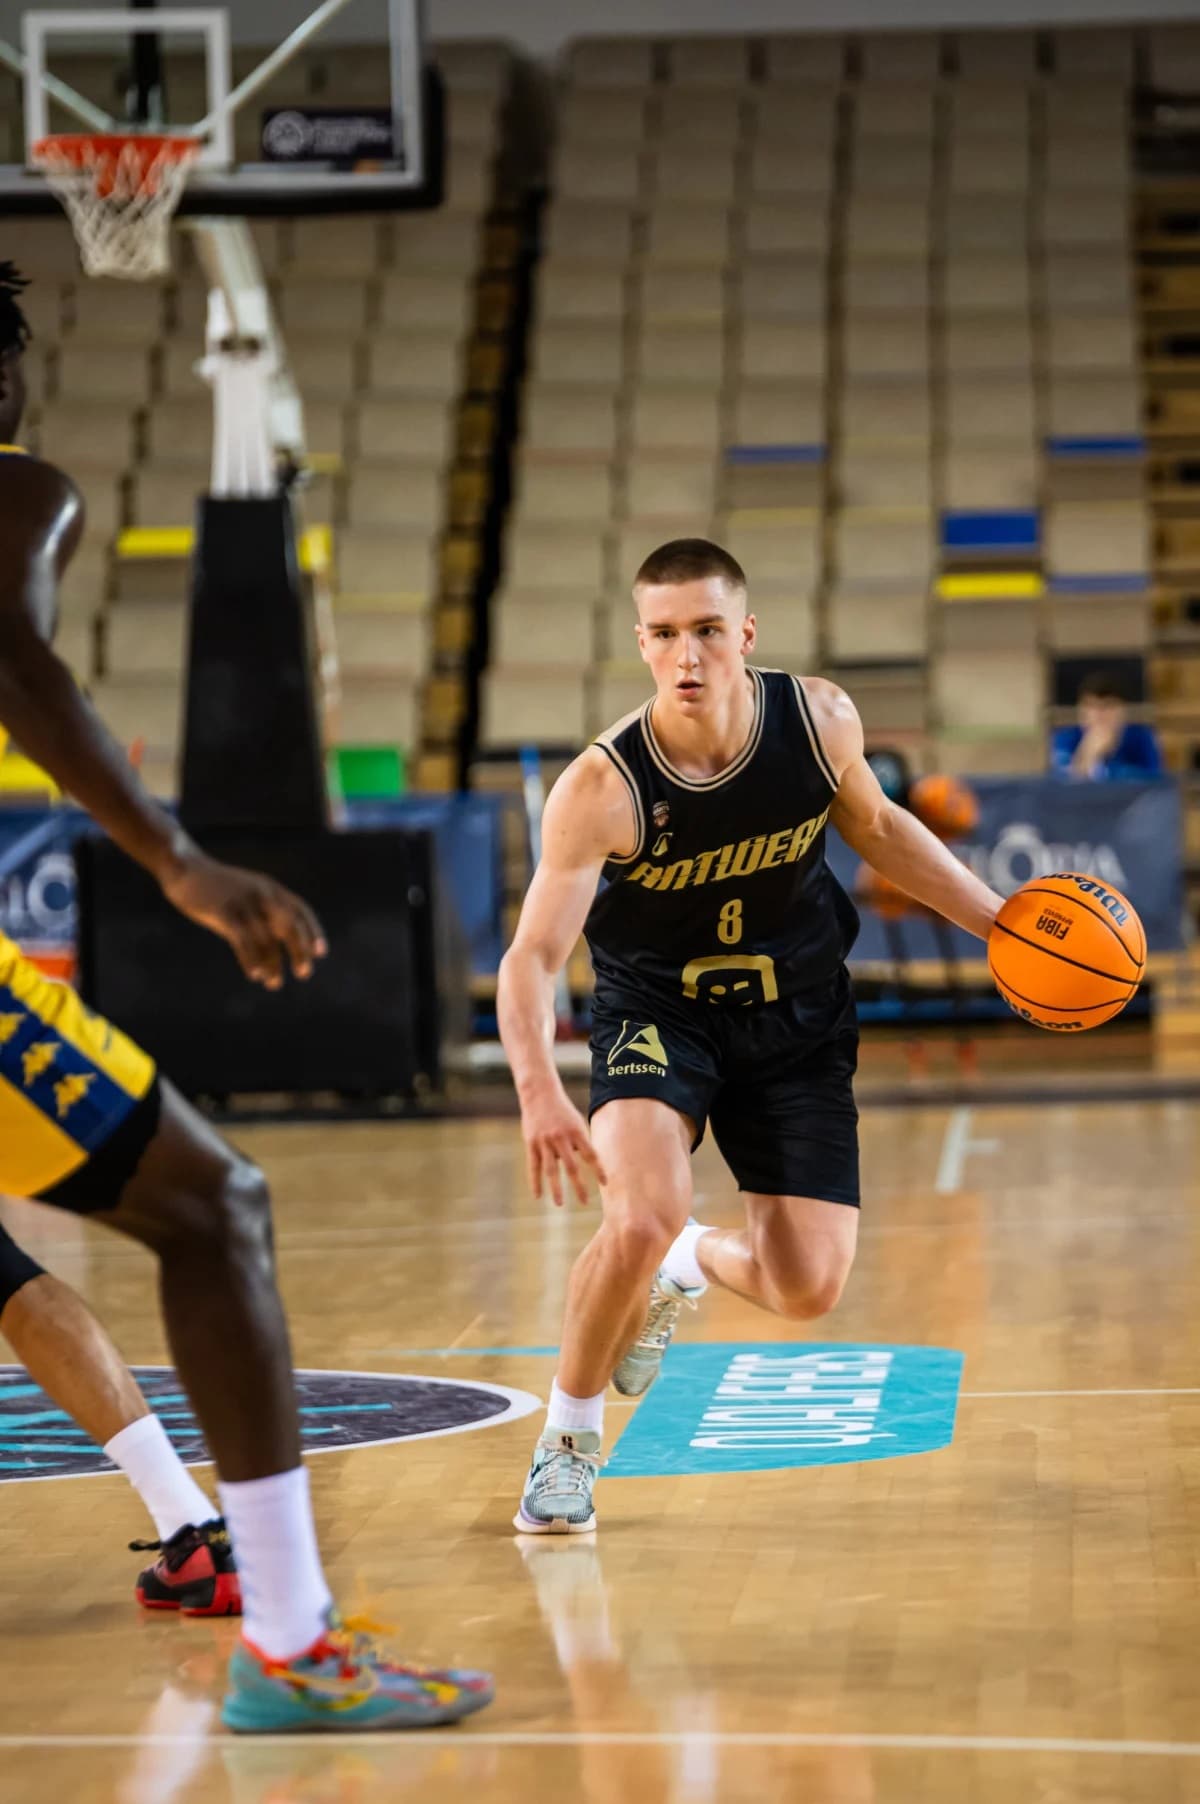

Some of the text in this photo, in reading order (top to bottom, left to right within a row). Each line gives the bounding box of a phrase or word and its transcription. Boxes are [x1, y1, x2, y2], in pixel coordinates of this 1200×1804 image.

[717, 898, 743, 945] 8
[1035, 914, 1070, 941] FIBA
[607, 1062, 667, 1078] aertssen
